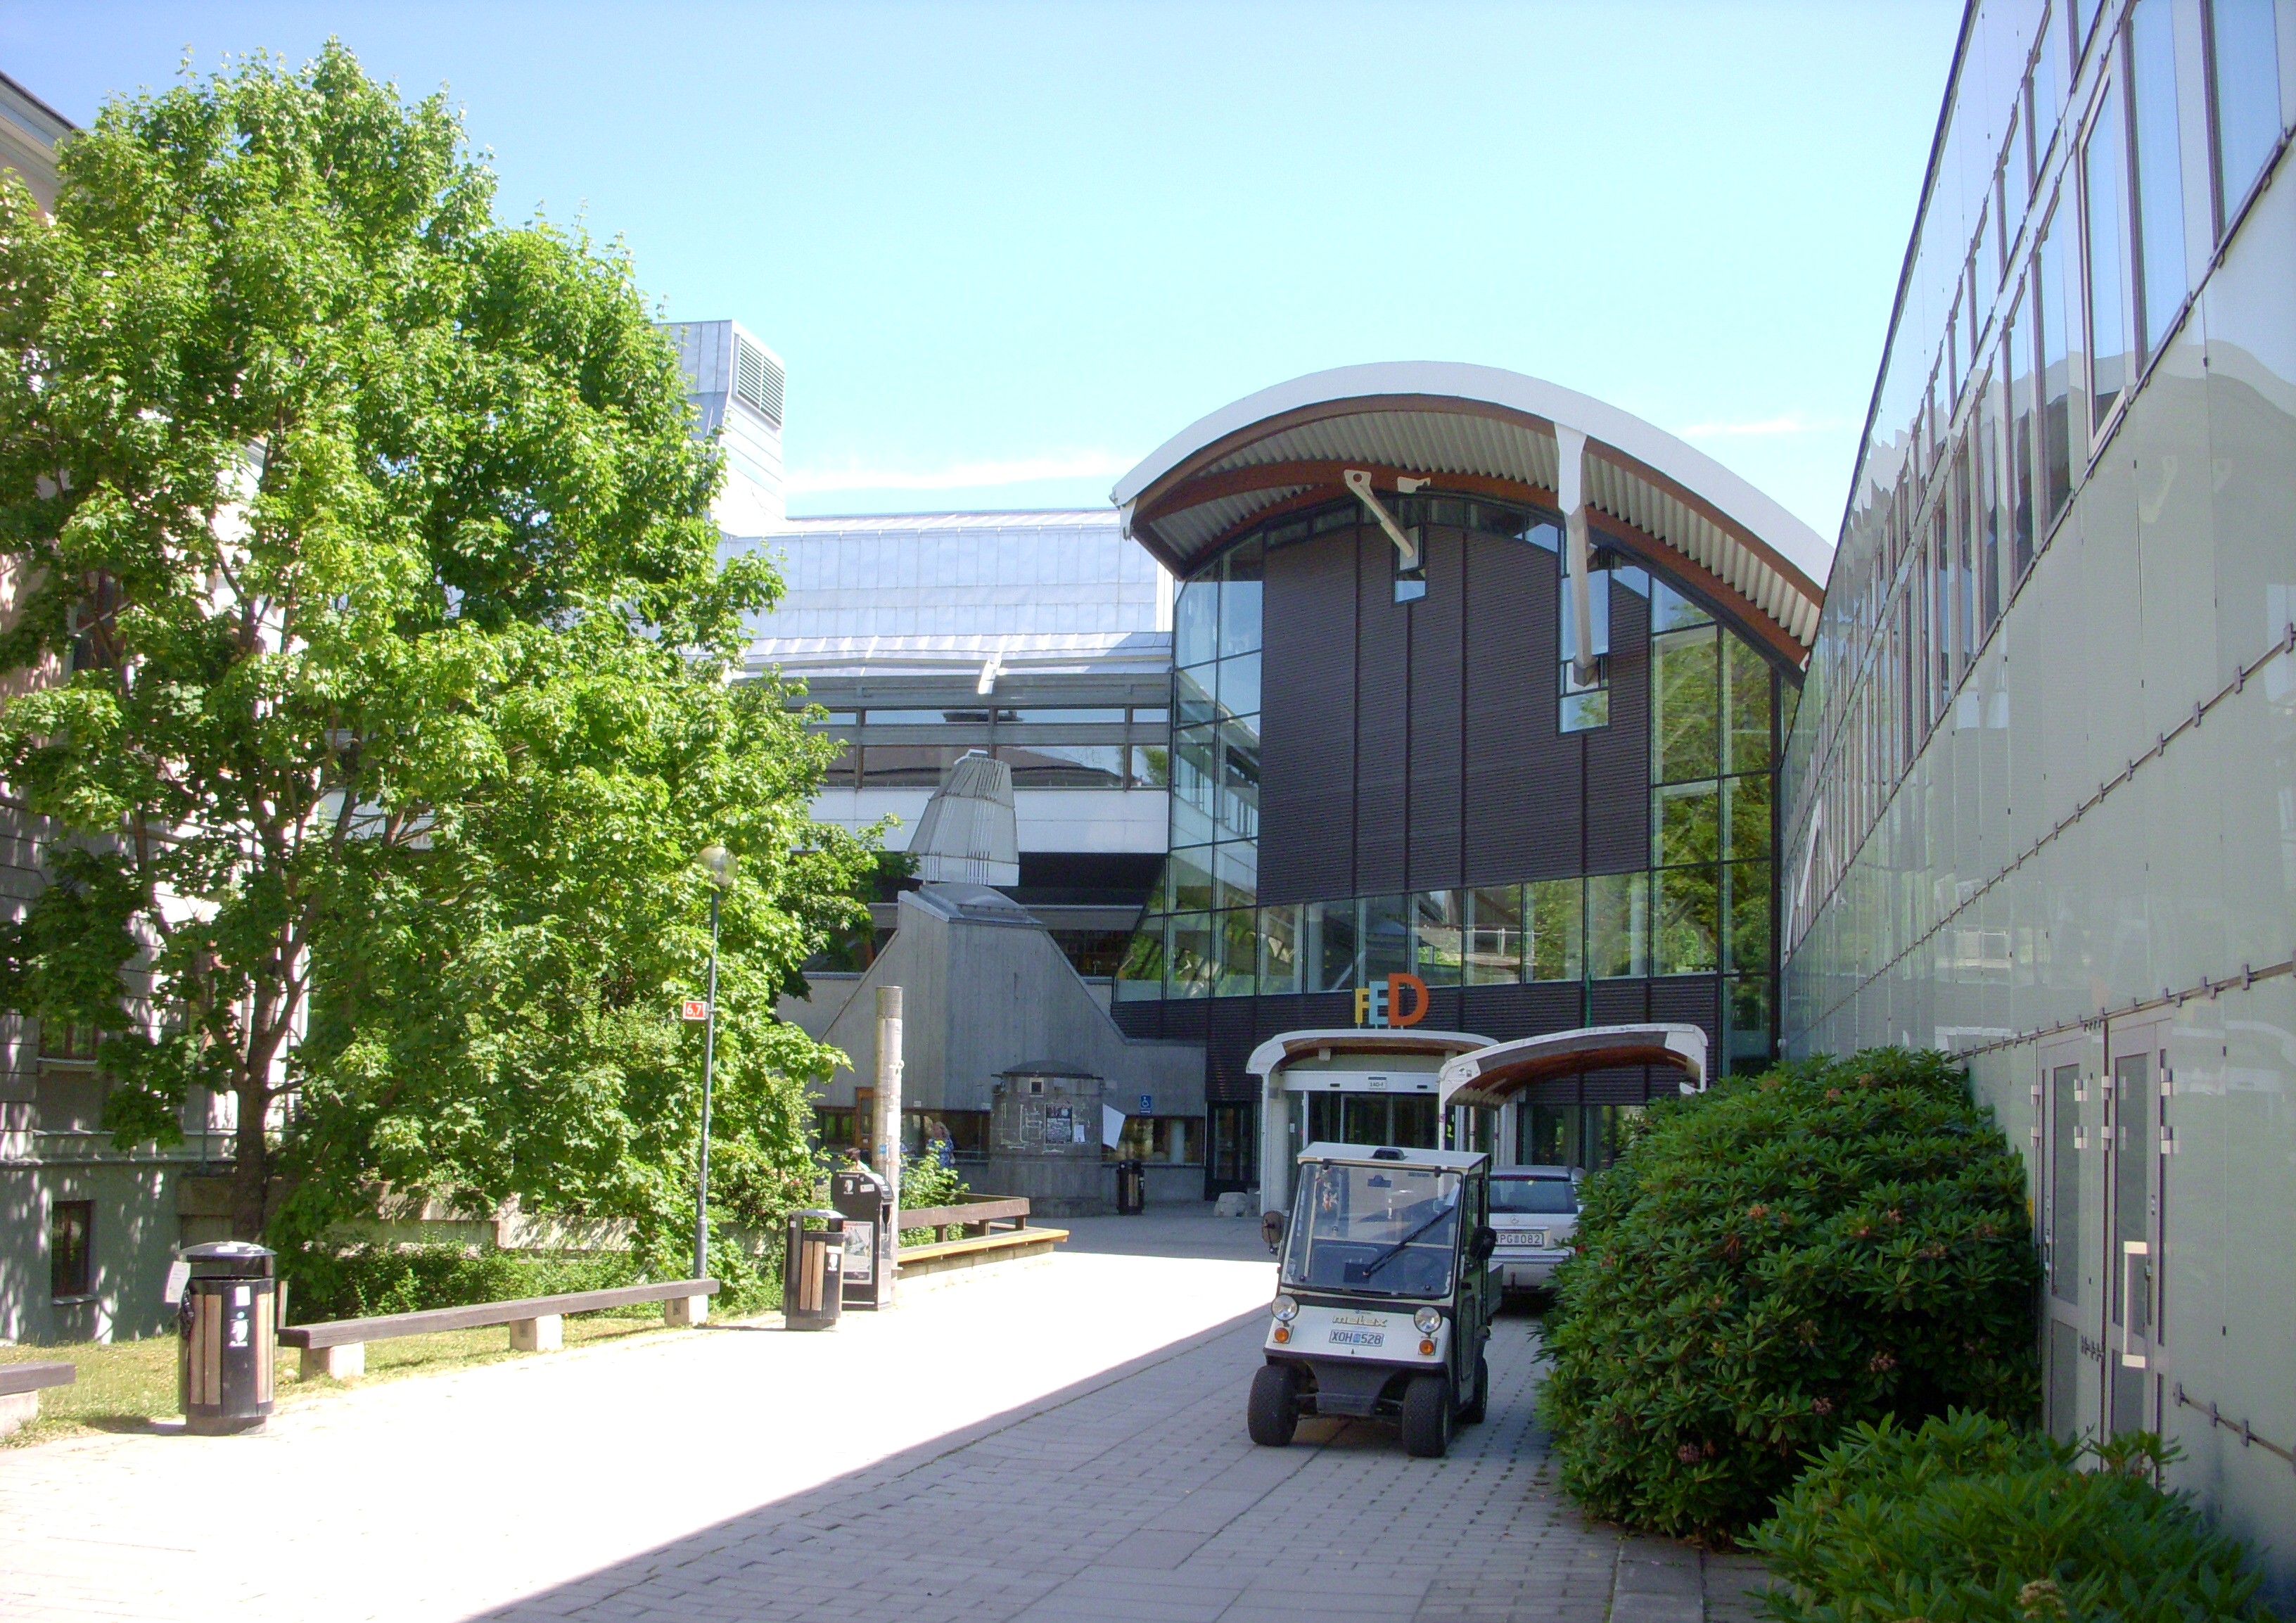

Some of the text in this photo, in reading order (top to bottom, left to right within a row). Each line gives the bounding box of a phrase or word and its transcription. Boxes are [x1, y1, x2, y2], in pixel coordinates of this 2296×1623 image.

[1355, 972, 1429, 1026] FED
[687, 1004, 702, 1017] 6,7
[1520, 1234, 1541, 1244] 082
[1360, 1334, 1382, 1344] 528
